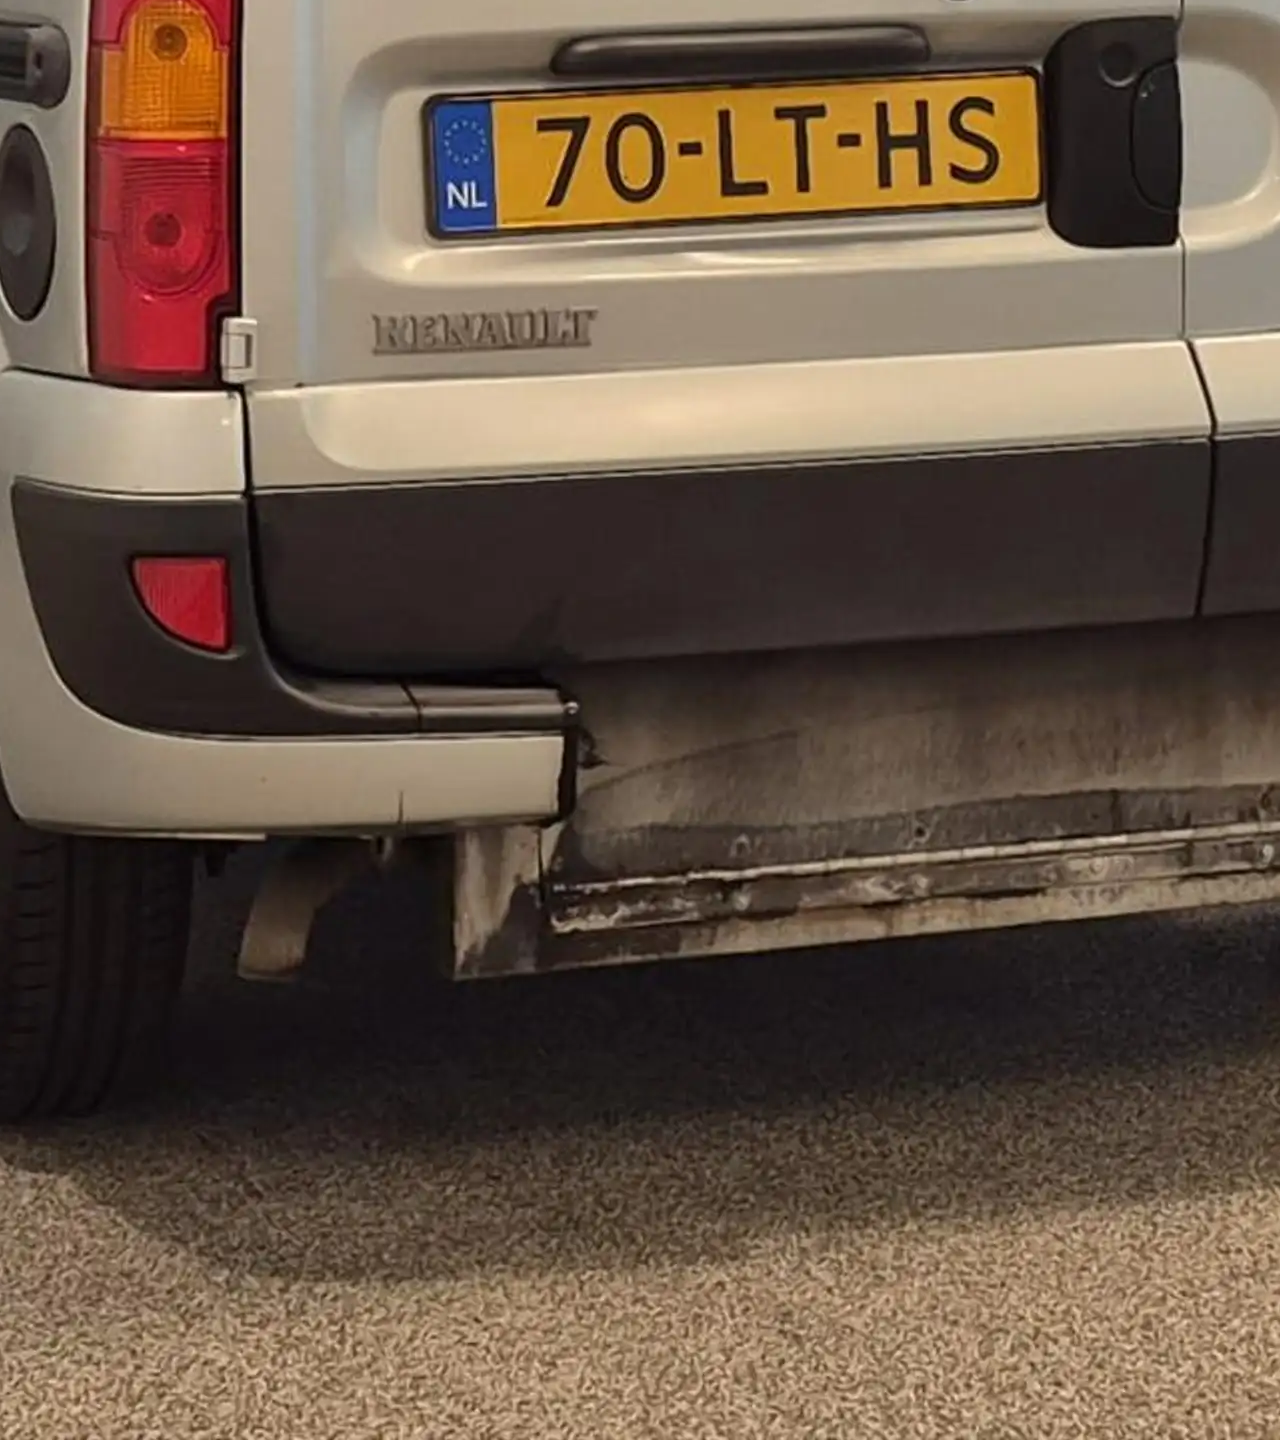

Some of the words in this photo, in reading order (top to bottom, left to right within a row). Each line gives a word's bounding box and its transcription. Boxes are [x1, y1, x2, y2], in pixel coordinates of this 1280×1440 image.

[536, 96, 1001, 207] 70-LT-HS
[447, 181, 488, 210] NL
[371, 306, 598, 356] RENAULT
